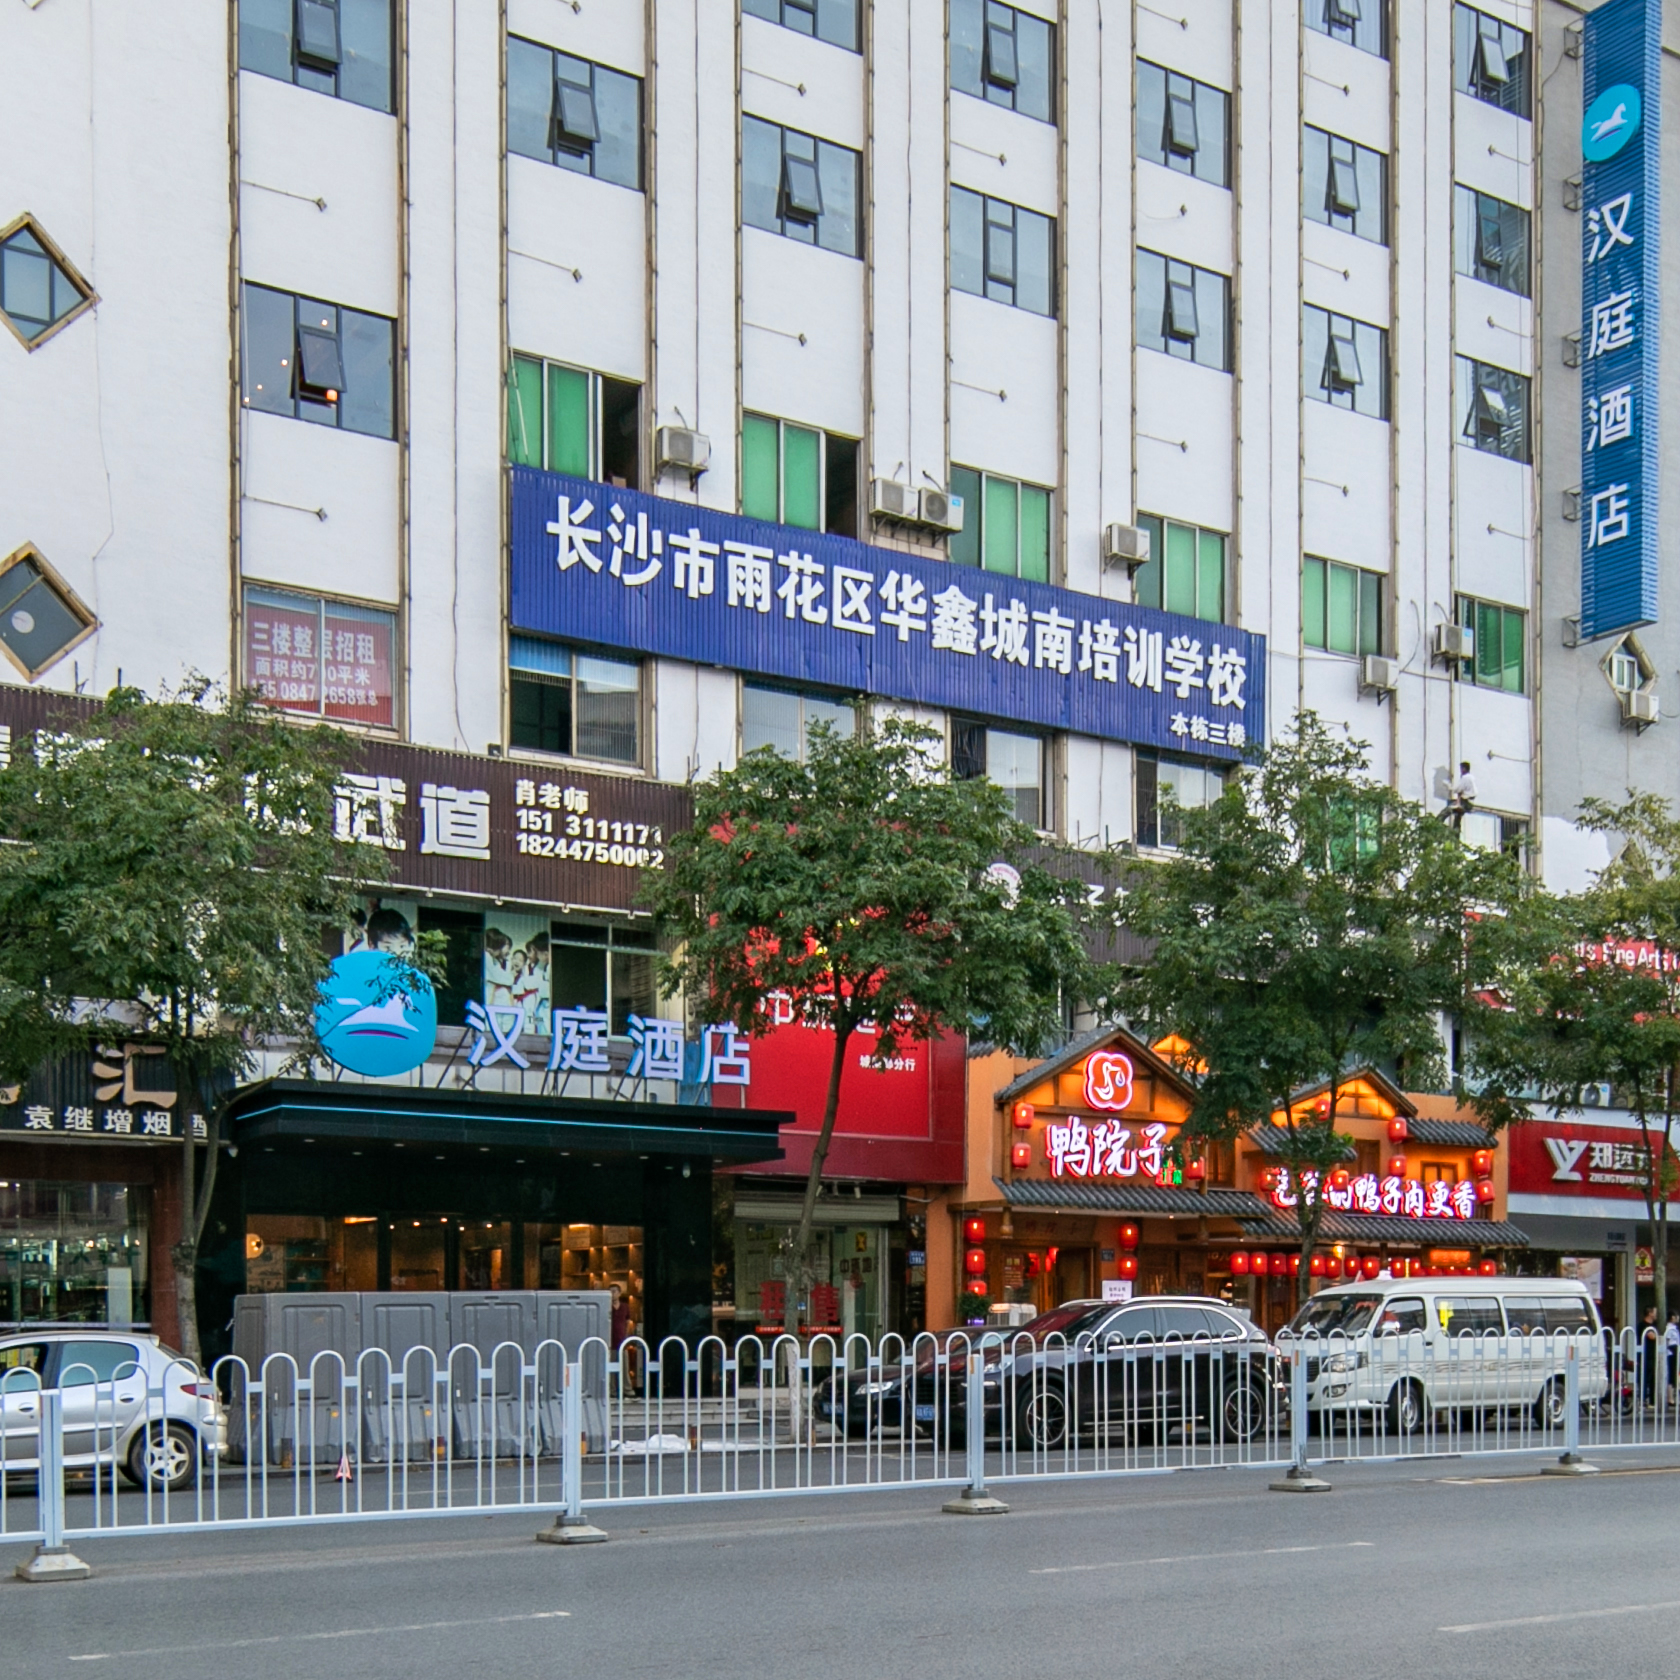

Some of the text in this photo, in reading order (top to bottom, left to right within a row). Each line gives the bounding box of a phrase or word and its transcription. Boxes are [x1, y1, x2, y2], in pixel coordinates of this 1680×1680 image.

[1587, 192, 1635, 550] 汉庭酒店
[546, 495, 1247, 710] 长沙市雨花区华鑫城南培训学校
[251, 621, 376, 665] 三楼整层招租
[1170, 711, 1247, 749] 本栋三楼
[516, 779, 590, 815] 肖老师
[516, 808, 553, 833] 151
[464, 998, 751, 1086] 汉庭酒店
[1047, 1115, 1168, 1178] 鸭院子
